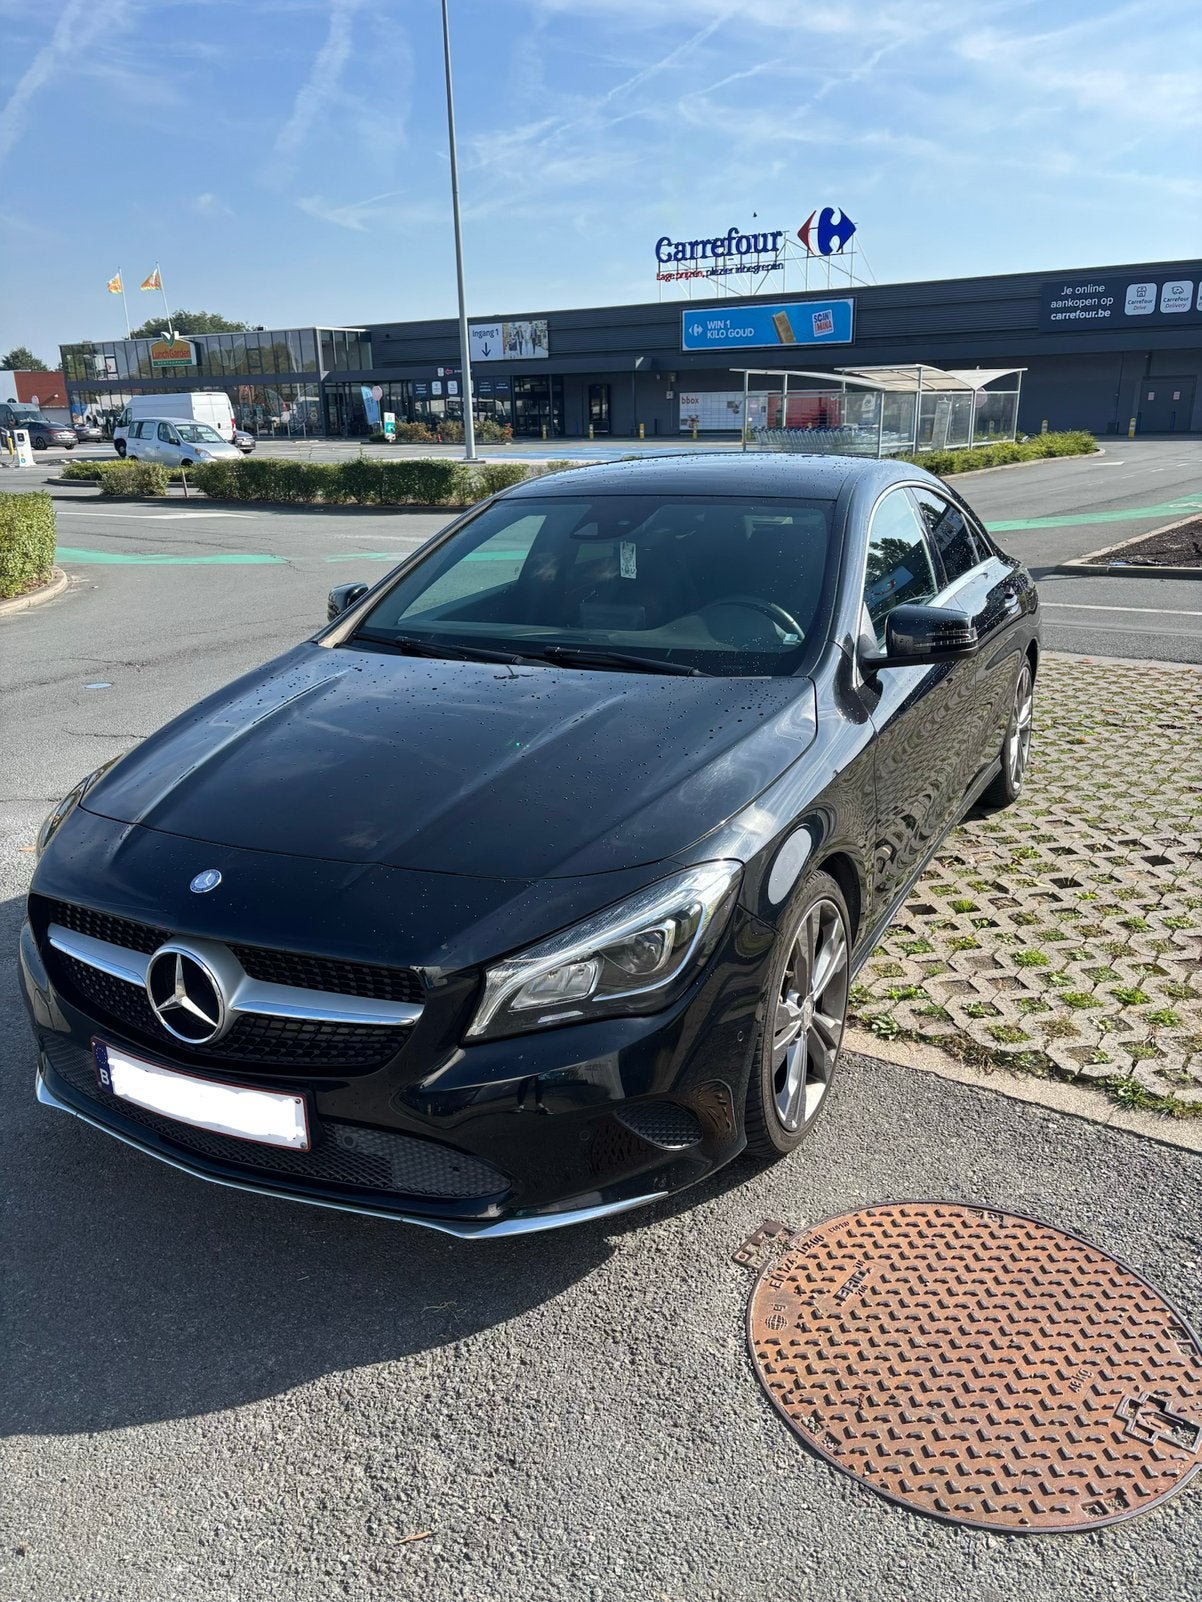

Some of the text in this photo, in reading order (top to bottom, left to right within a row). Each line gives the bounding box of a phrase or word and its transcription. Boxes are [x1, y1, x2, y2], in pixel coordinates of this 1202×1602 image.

[655, 227, 783, 264] Carrefour
[1061, 284, 1106, 295] Je online
[1050, 297, 1114, 308] aankopen op
[1163, 295, 1190, 303] Carrefour
[1050, 308, 1111, 320] carrefour.be
[706, 319, 731, 330] WIN 1
[706, 327, 755, 339] KILO GOUD
[681, 396, 700, 404] bbox
[99, 1068, 110, 1085] B
